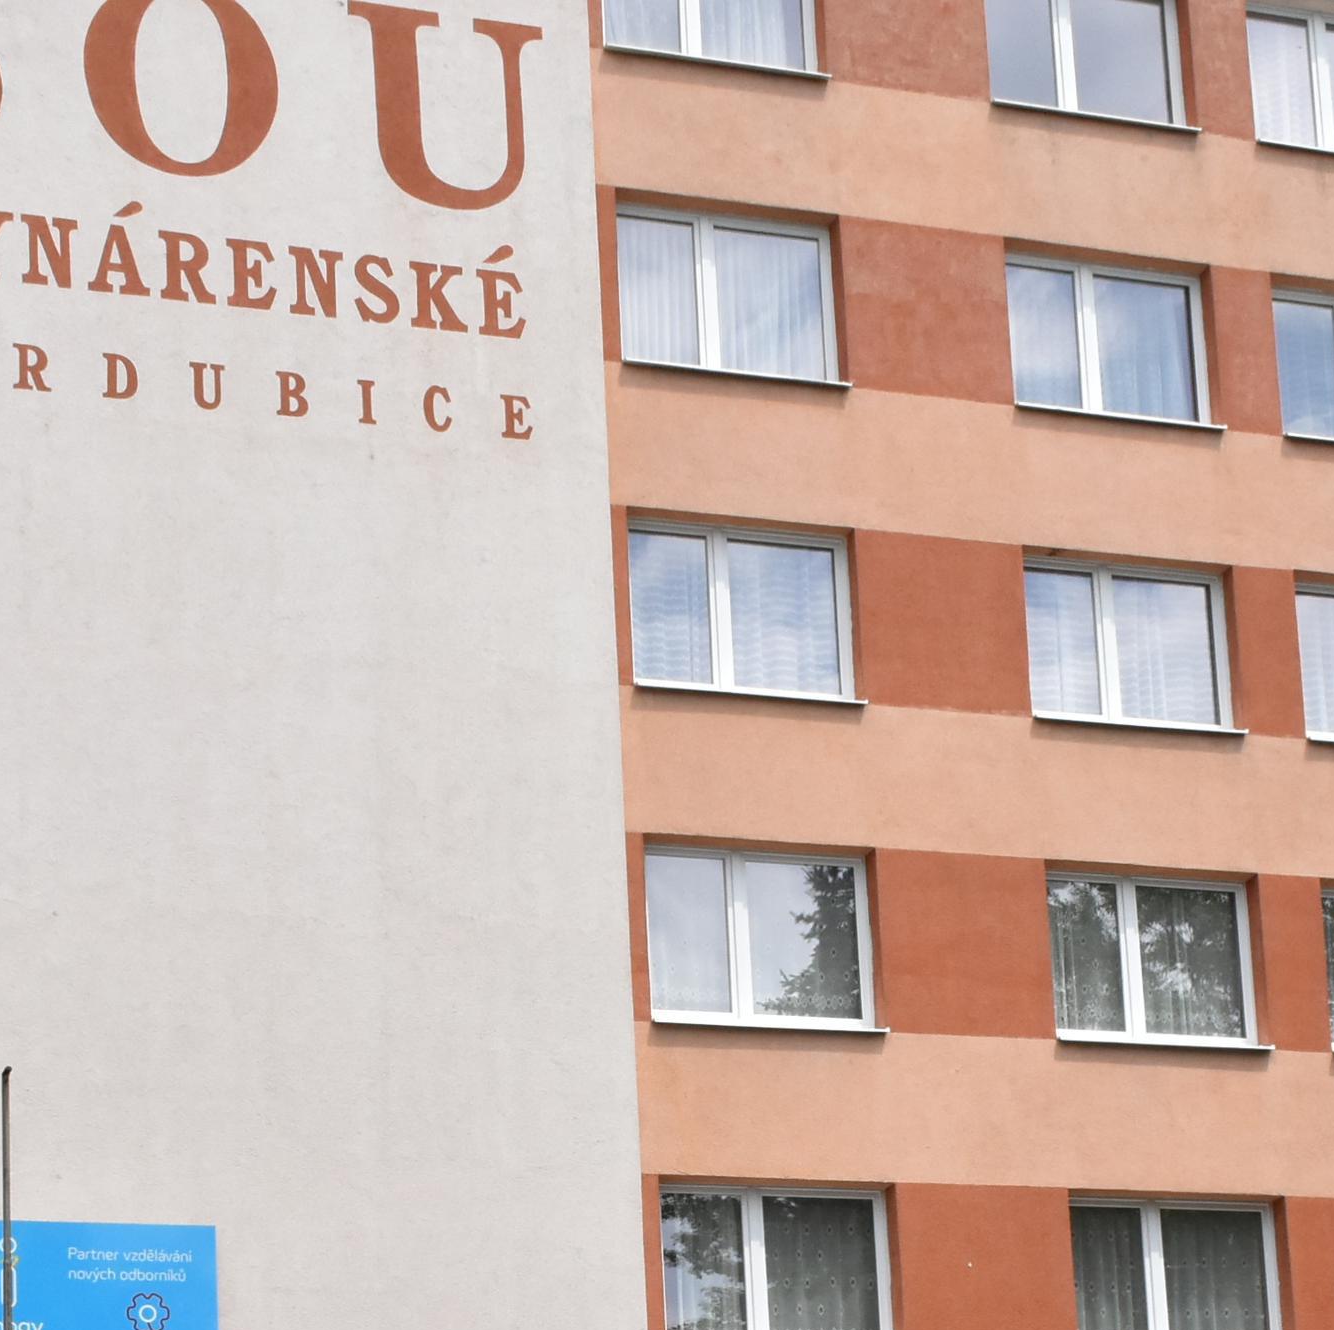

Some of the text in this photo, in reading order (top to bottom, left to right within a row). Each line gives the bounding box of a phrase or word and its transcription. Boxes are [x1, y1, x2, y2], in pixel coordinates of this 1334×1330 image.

[67, 1246, 193, 1263] Partner vzdělávání
[68, 1267, 187, 1283] nových odborníků
